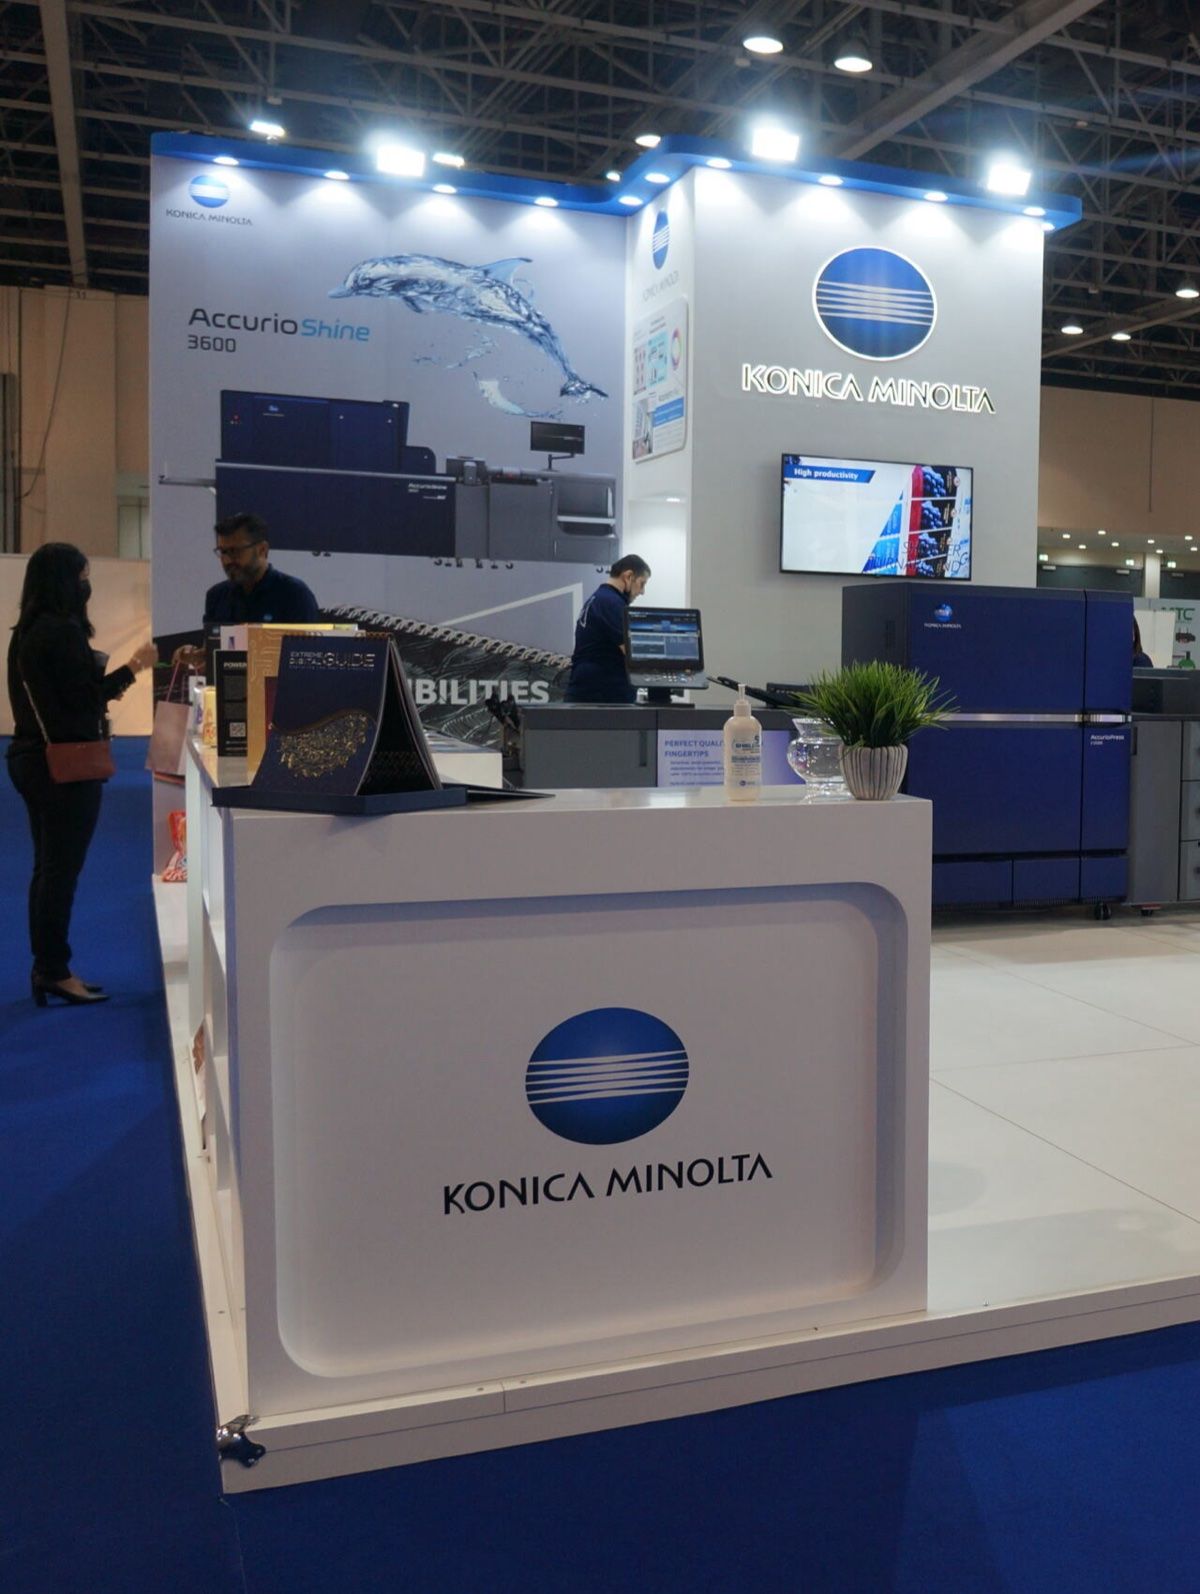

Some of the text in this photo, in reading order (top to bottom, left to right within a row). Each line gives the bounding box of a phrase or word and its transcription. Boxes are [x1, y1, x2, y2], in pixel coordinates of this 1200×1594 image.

[166, 209, 253, 226] KONICA MINOLTA
[188, 334, 236, 353] 3600
[741, 363, 997, 414] KONICA MINOLTA
[794, 468, 859, 481] High productivity
[700, 740, 723, 748] QUALI
[443, 1152, 773, 1215] KONICA MINOLTA
